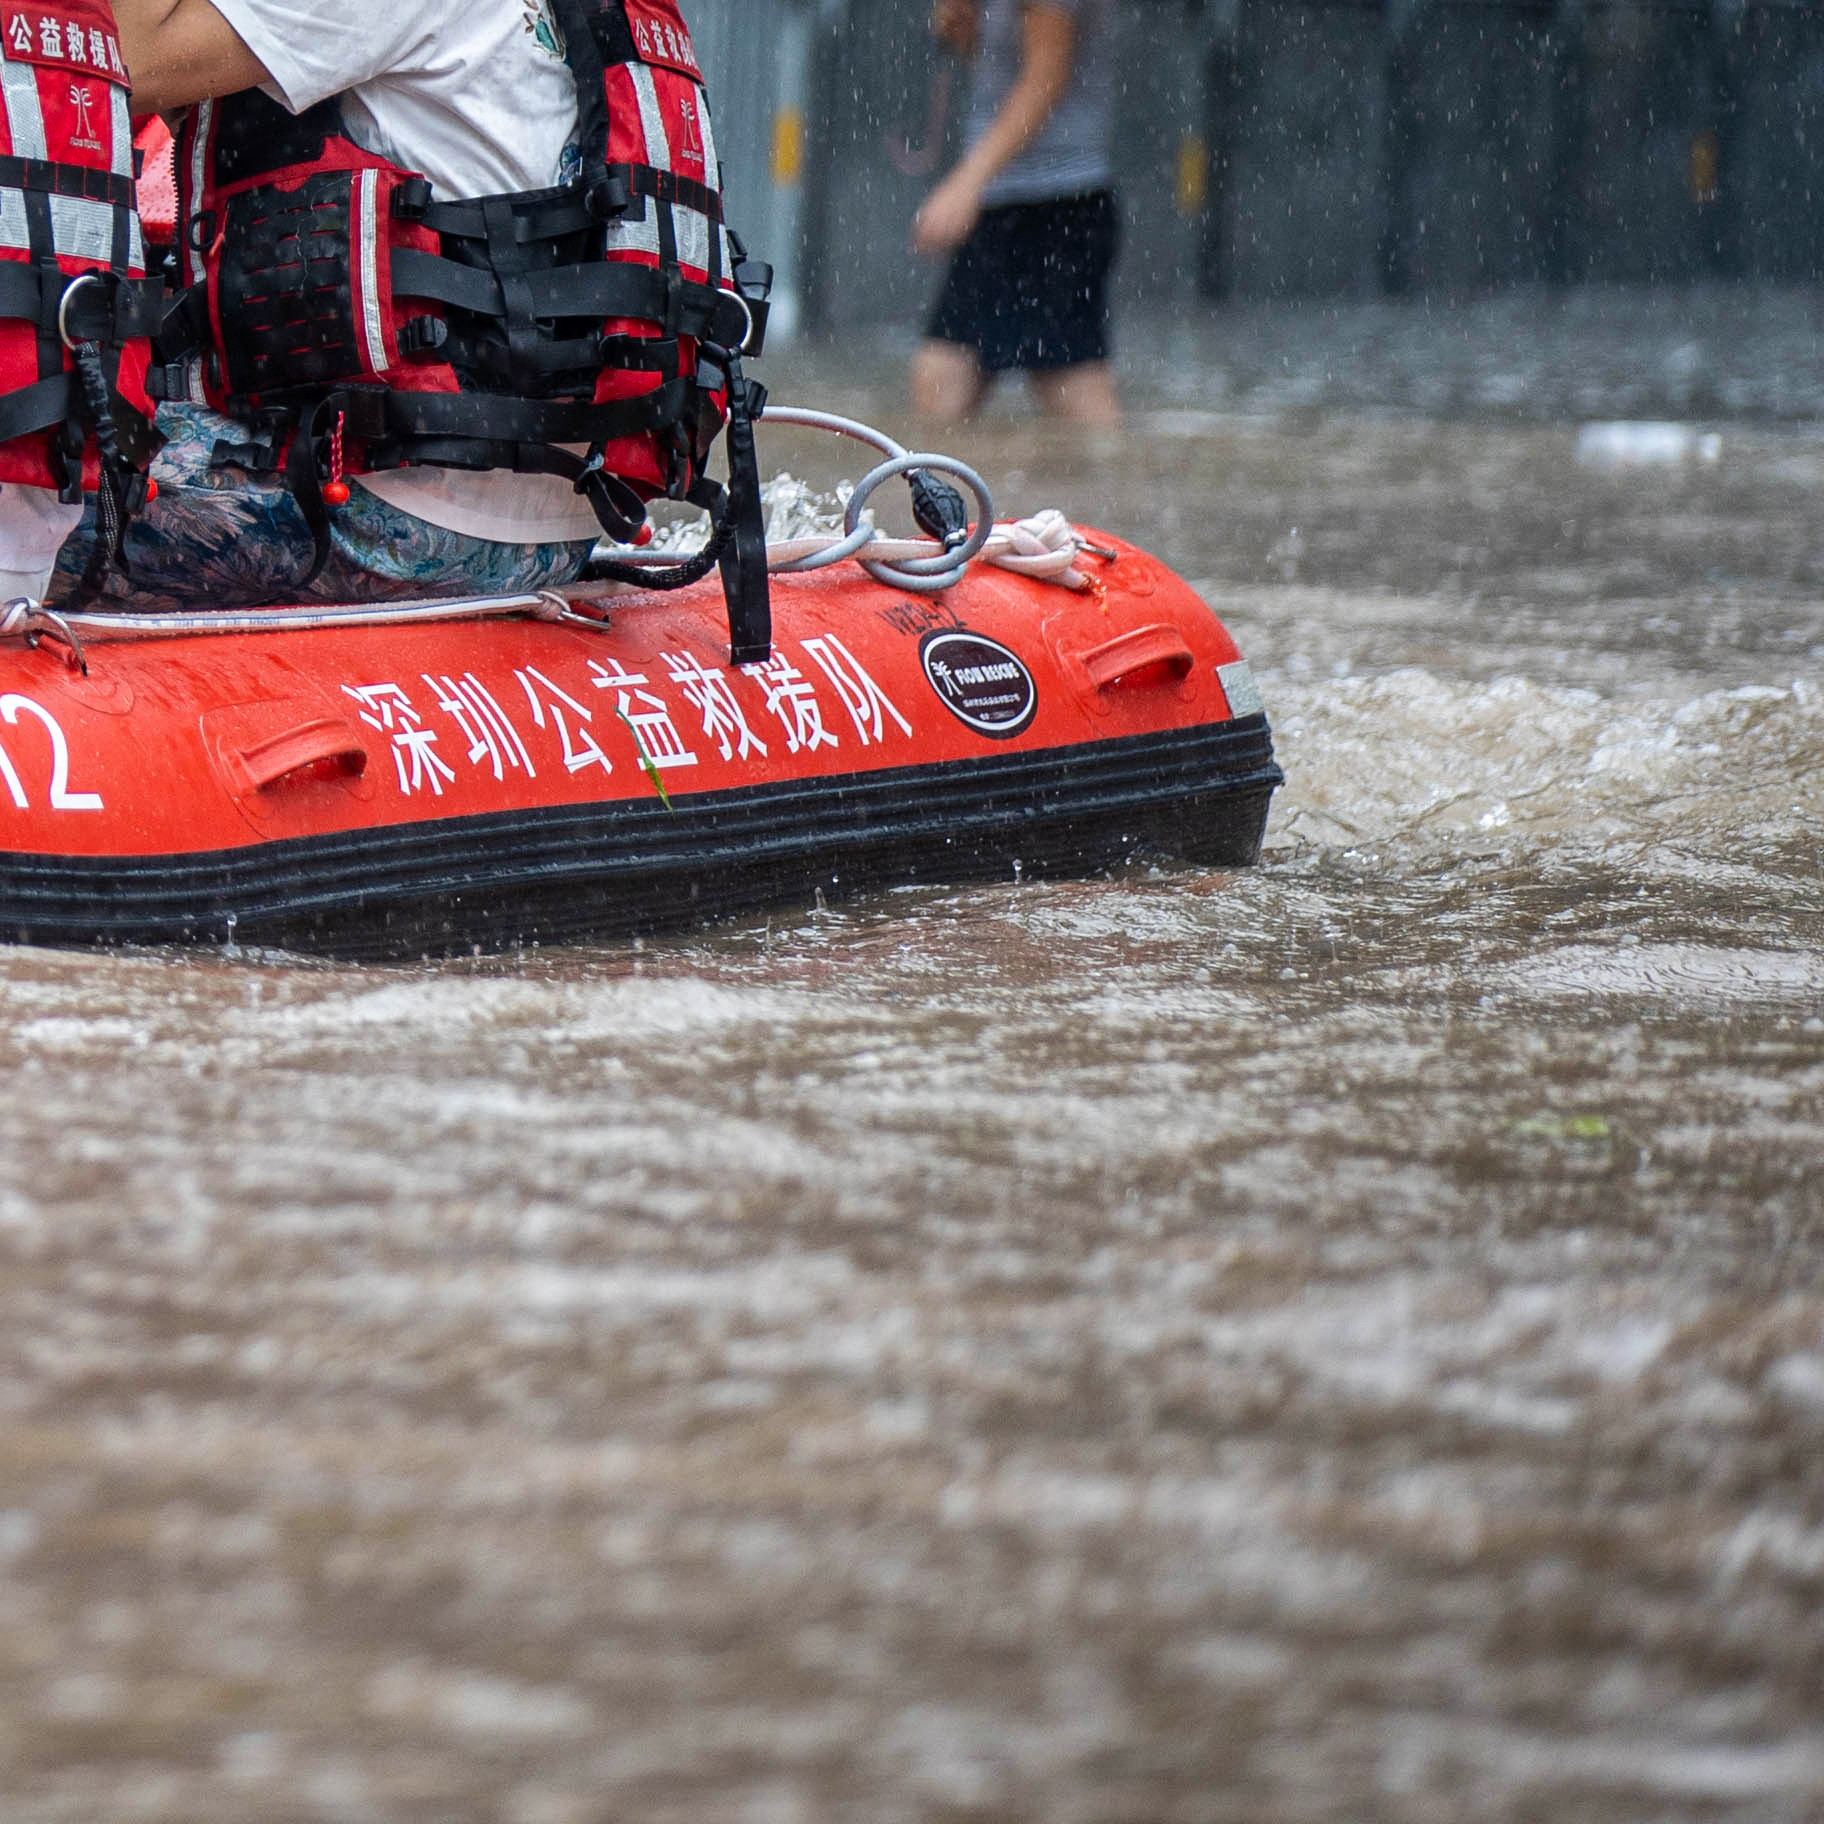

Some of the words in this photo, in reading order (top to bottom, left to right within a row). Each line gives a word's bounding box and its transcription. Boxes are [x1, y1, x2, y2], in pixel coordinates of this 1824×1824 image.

[9, 14, 126, 77] 公益救援队
[341, 633, 912, 796] 深圳公益救援队
